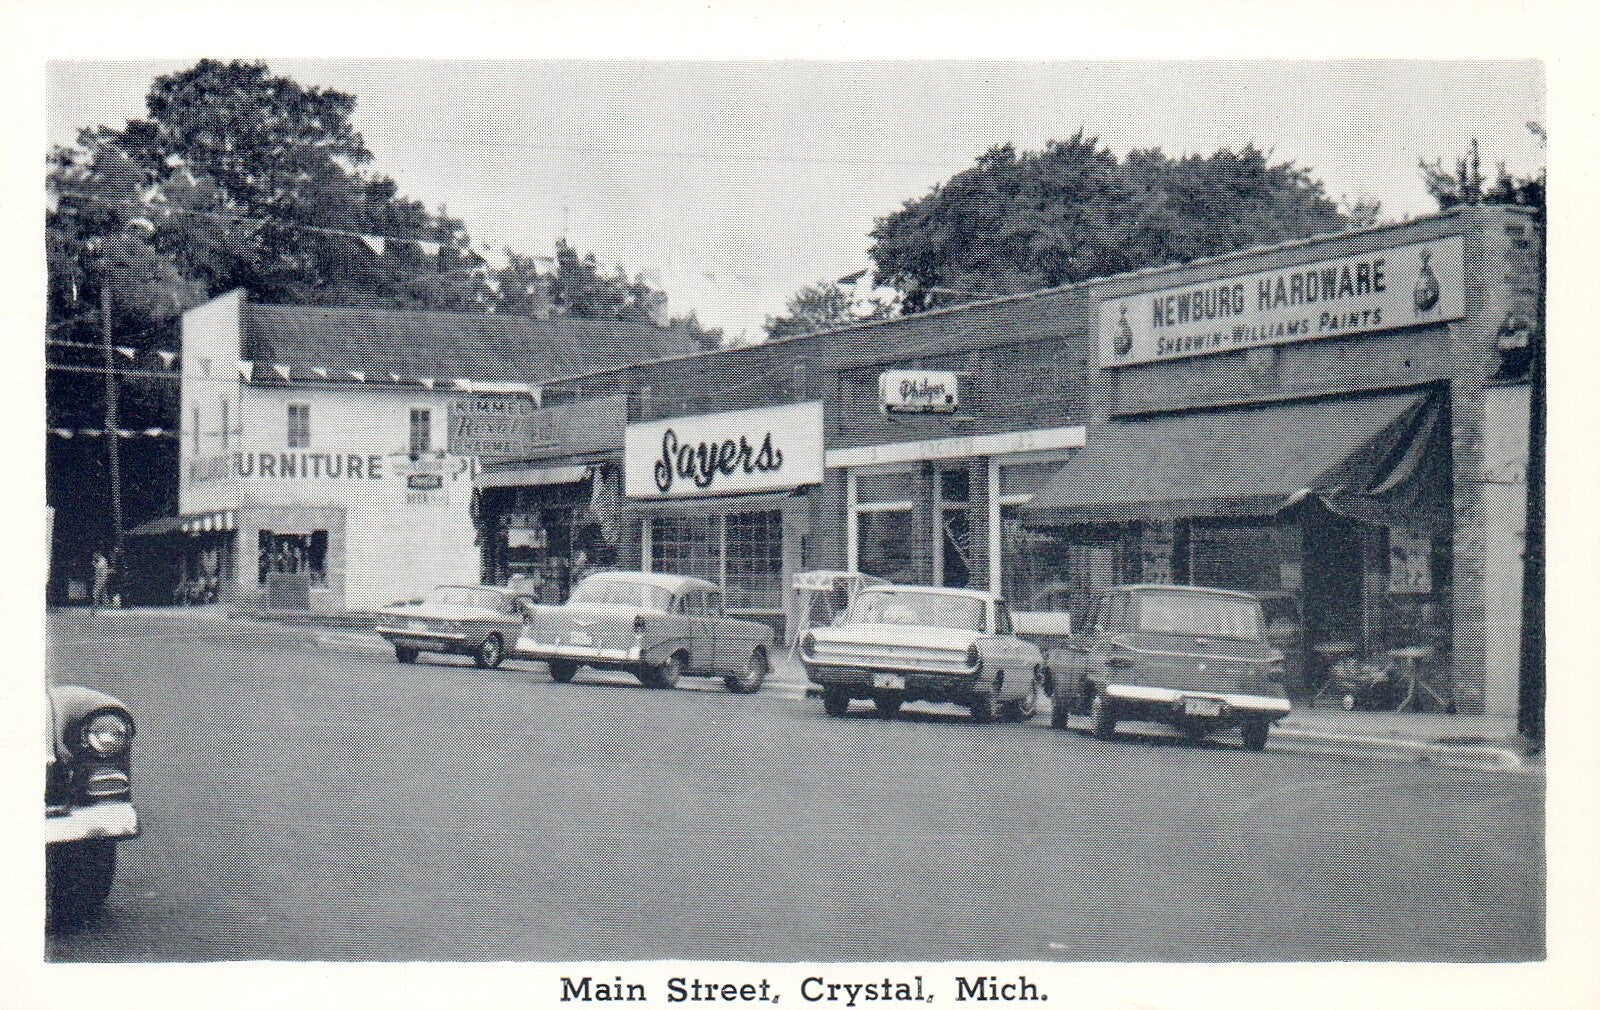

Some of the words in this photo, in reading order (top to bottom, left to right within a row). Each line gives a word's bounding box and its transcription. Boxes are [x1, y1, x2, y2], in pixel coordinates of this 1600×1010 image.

[1152, 283, 1245, 329] NEWBURG
[1258, 258, 1387, 311] HARDWARE
[1156, 318, 1309, 356] SHERWIN-WILLIAMS
[1318, 307, 1383, 333] PAINTS
[654, 429, 783, 492] Sayers
